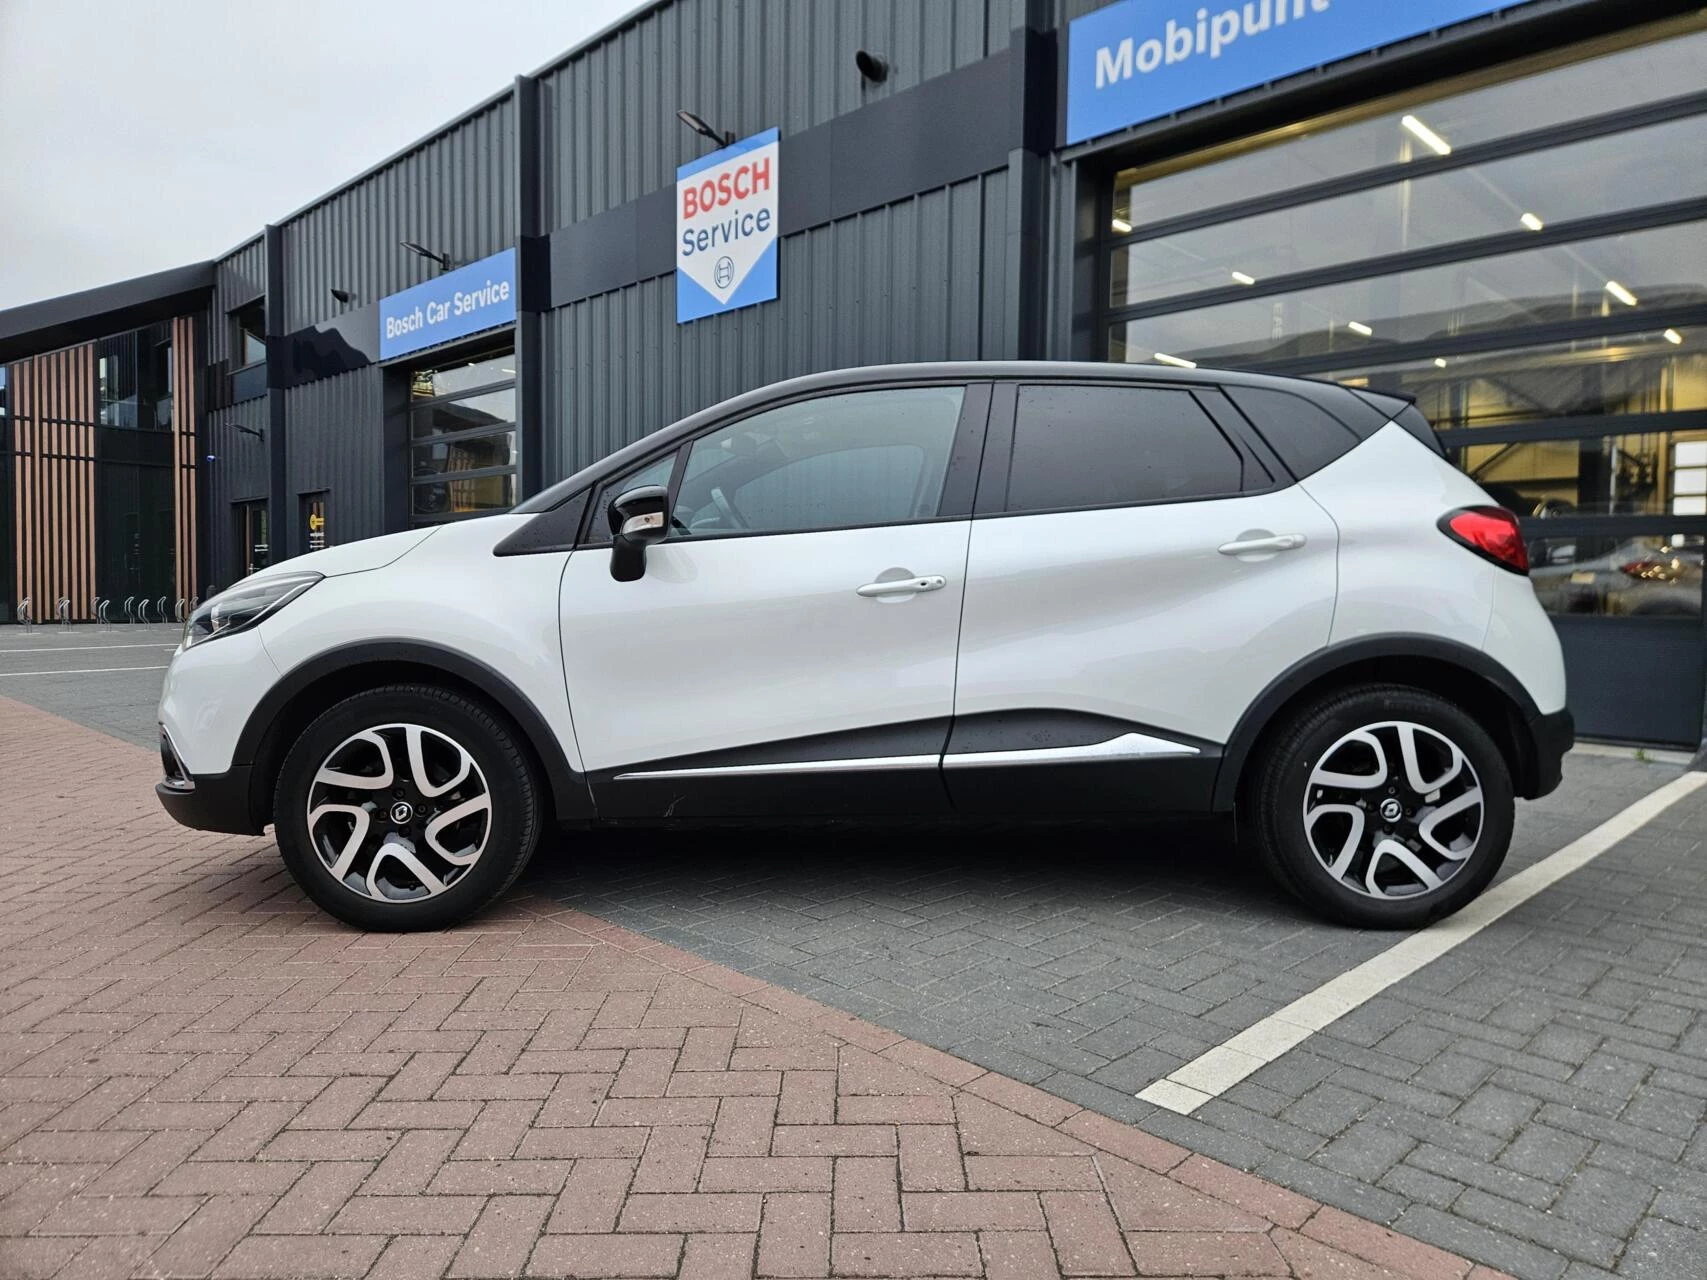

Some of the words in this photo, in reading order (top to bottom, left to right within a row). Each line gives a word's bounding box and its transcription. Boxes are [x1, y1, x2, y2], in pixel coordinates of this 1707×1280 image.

[1095, 0, 1330, 89] Mobipun
[683, 156, 770, 220] BOSCH
[682, 208, 770, 257] Service
[386, 306, 423, 339] Bosch
[426, 301, 451, 325] Car
[453, 280, 510, 316] Service
